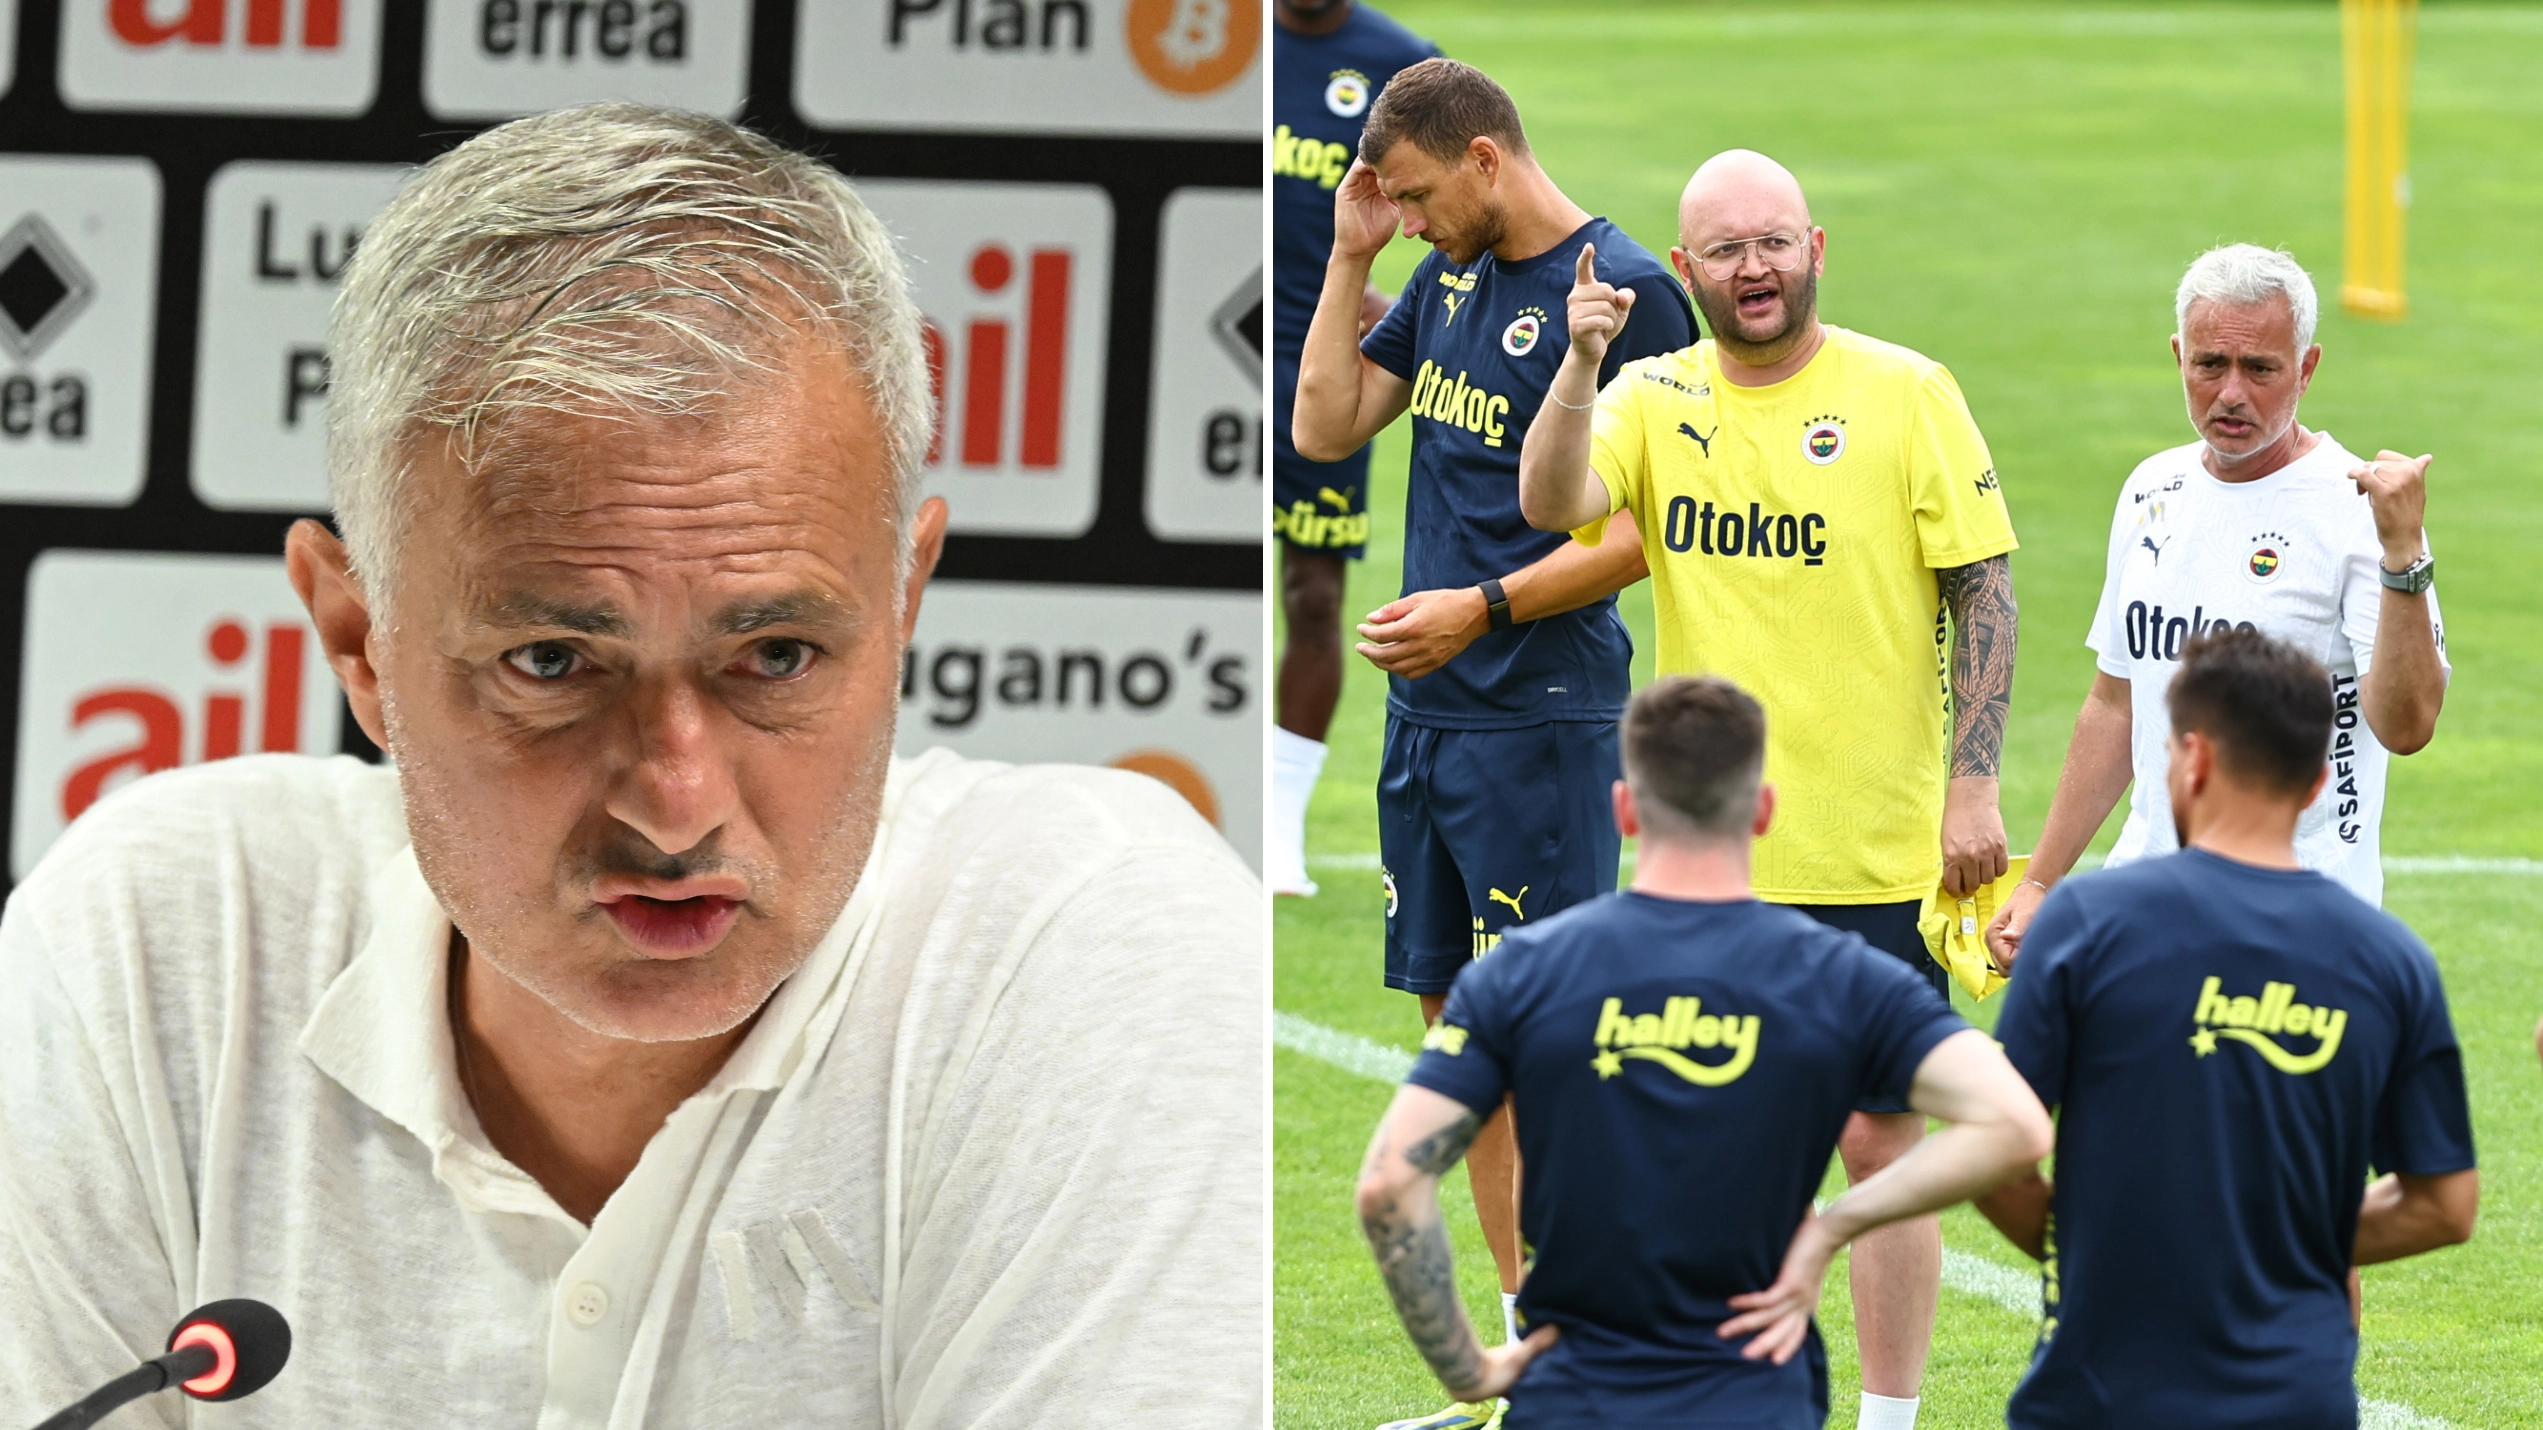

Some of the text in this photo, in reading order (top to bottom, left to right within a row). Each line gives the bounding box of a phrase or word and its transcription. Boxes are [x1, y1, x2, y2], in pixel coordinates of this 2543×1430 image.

[1273, 123, 1350, 190] koç
[258, 202, 362, 283] Lu
[2, 374, 86, 441] ea
[285, 347, 334, 428] P
[1411, 358, 1510, 448] Otokoç
[1642, 371, 1710, 396] WORLD
[2135, 480, 2184, 504] WOLD
[1664, 495, 1826, 566] Otokoç
[2125, 599, 2259, 662] Otok
[1591, 995, 1761, 1087] halley
[2190, 974, 2348, 1075] halley
